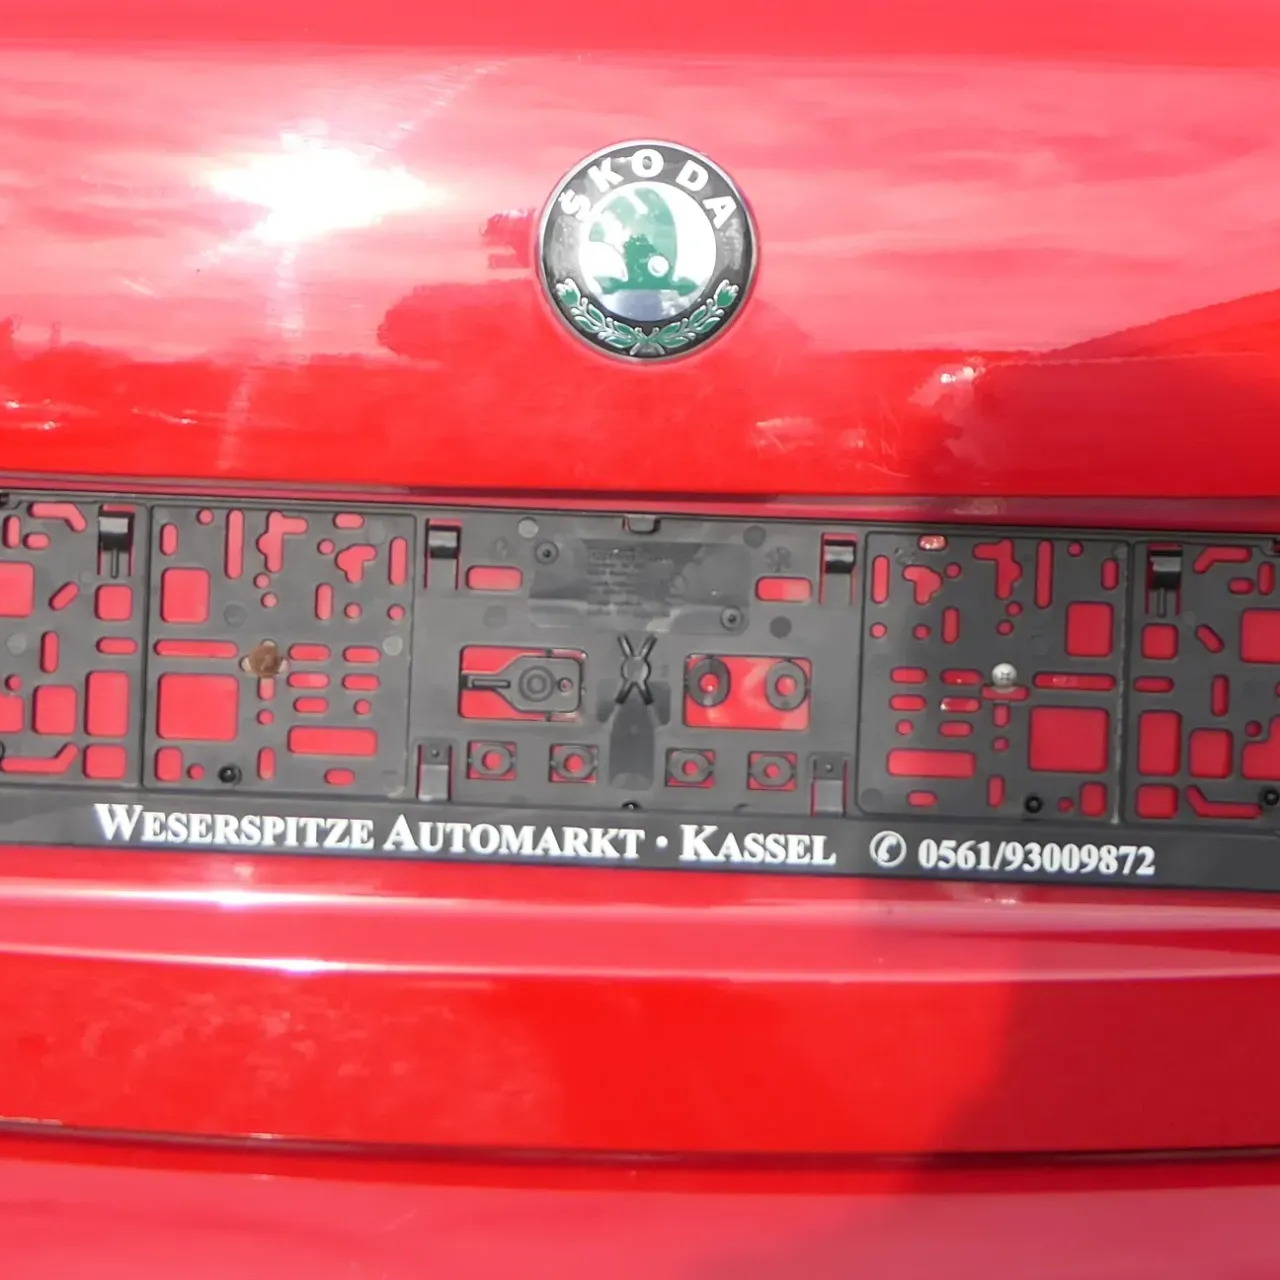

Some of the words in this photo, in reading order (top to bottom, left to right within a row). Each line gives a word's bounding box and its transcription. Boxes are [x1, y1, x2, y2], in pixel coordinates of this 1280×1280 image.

[94, 803, 375, 851] WESERSPITZE
[383, 813, 646, 860] AUTOMARKT
[679, 824, 838, 867] KASSEL
[917, 838, 1157, 876] 0561/93009872
